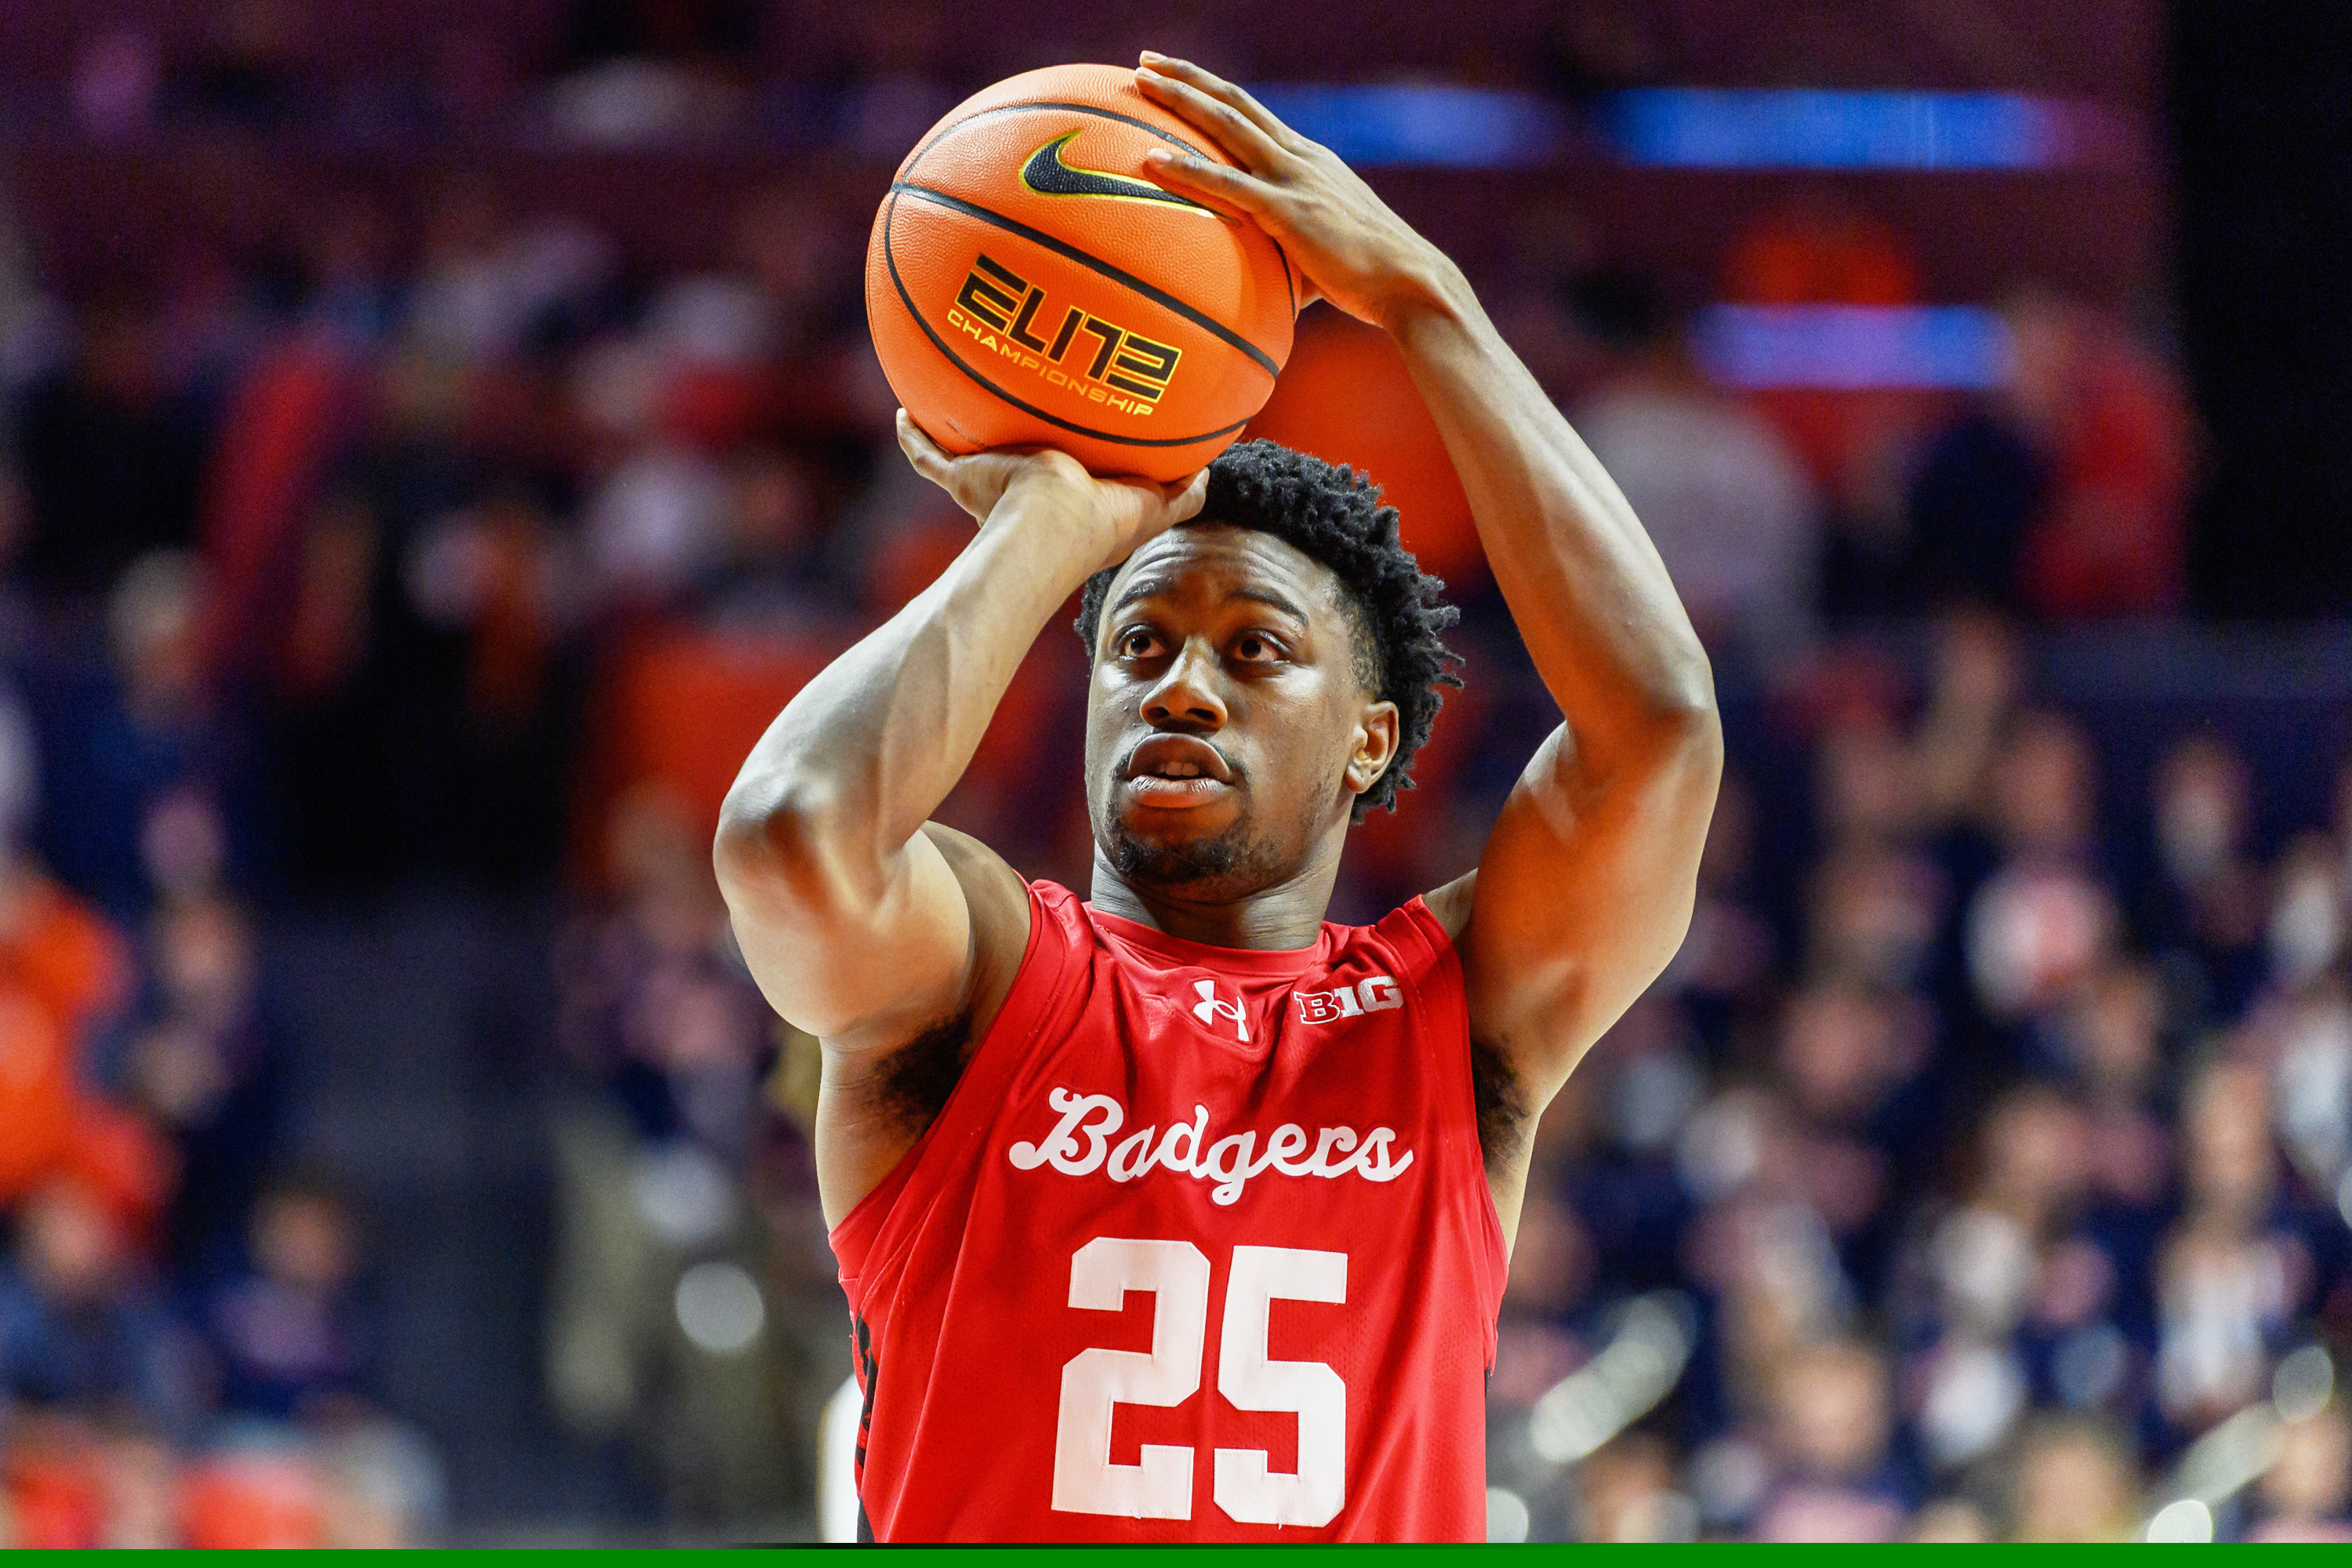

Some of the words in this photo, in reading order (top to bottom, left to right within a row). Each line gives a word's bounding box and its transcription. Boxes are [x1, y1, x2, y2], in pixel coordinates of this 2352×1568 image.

[947, 309, 1154, 416] CHAMPIONSHIP
[954, 252, 1182, 403] ELITE
[1009, 1087, 1414, 1206] Badgers
[1051, 1236, 1348, 1528] 25
